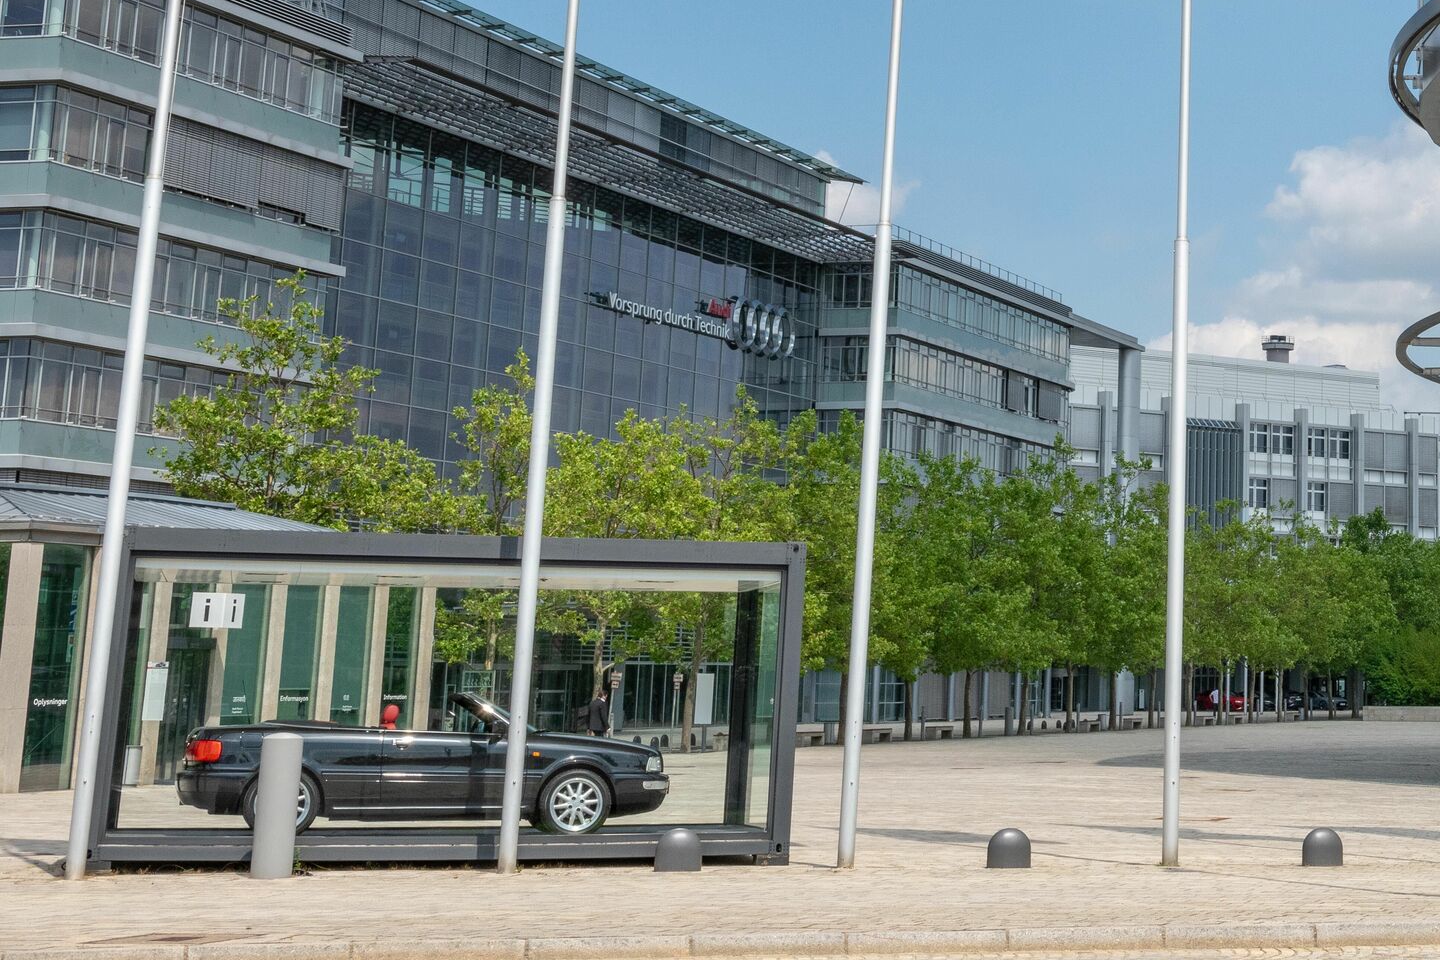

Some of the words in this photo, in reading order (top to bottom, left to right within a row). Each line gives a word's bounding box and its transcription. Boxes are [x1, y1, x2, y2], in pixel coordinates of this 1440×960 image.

[609, 291, 663, 324] Vorsprung
[665, 308, 693, 330] durch
[695, 316, 730, 339] Technik
[706, 298, 732, 318] Audi
[33, 698, 68, 707] Oplysninger
